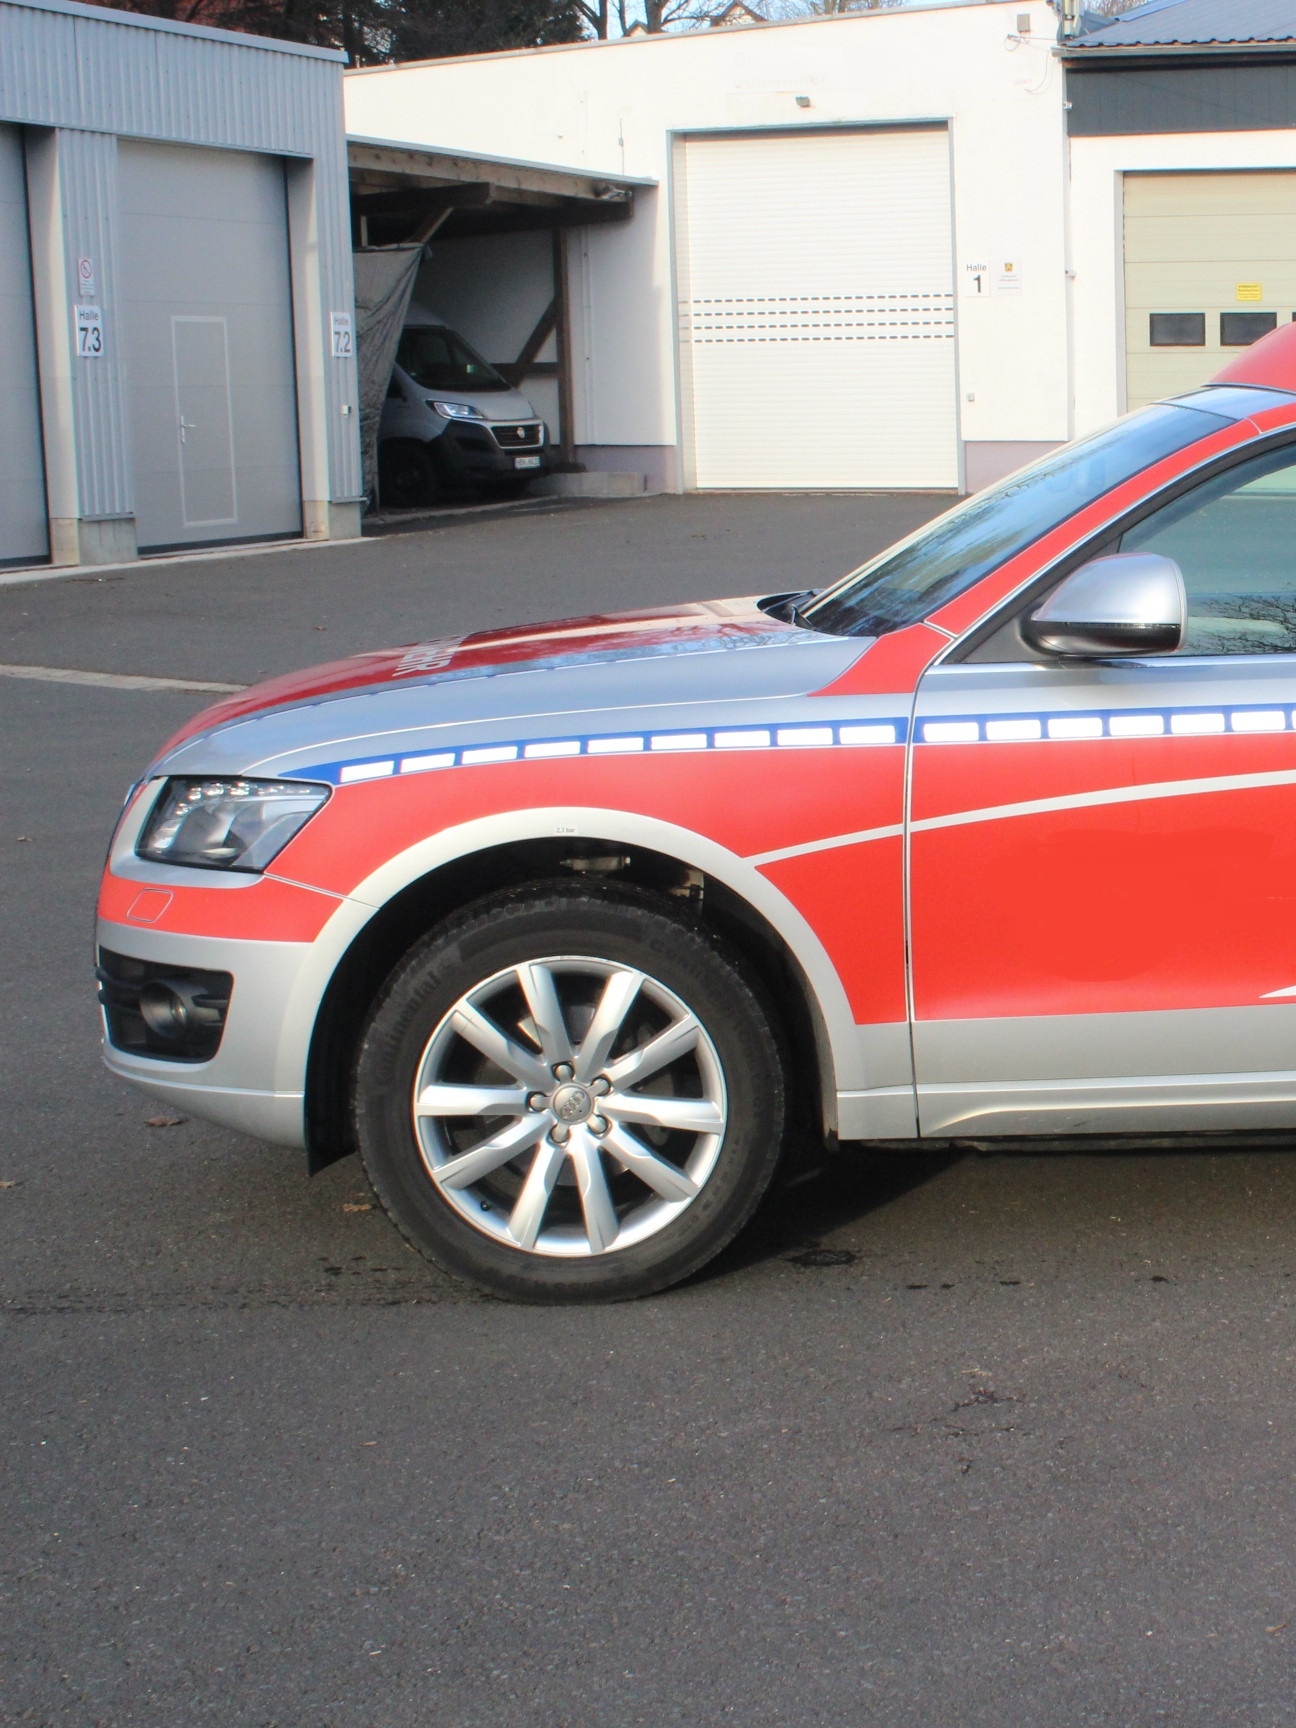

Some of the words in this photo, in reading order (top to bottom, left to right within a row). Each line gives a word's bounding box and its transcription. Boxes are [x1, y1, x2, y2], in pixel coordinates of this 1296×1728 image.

[966, 263, 987, 272] Halle
[973, 274, 981, 293] 1
[79, 310, 99, 321] Halle
[334, 315, 349, 326] Halle
[79, 327, 101, 353] 7.3
[334, 331, 351, 353] 7.2
